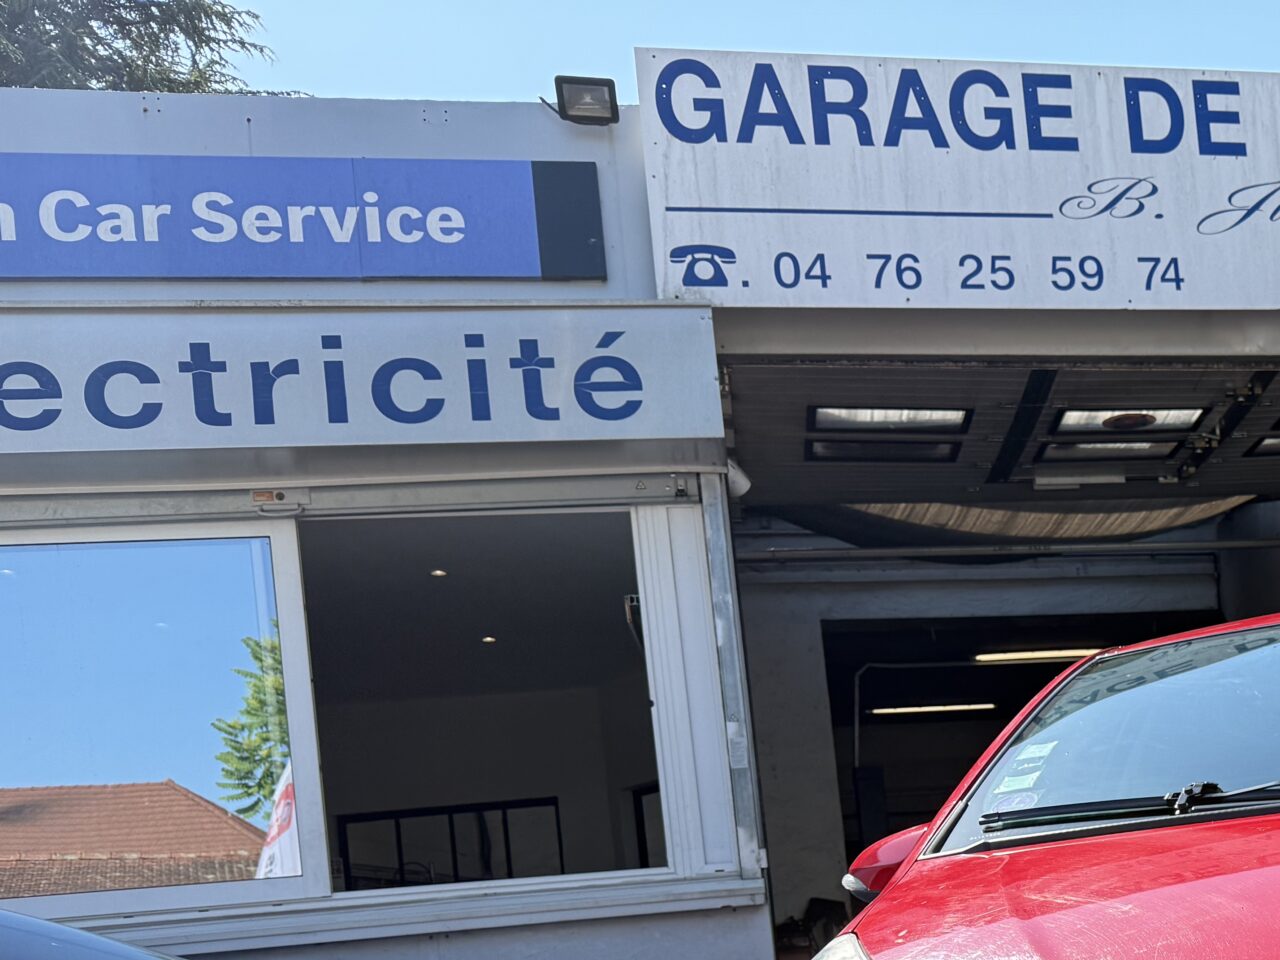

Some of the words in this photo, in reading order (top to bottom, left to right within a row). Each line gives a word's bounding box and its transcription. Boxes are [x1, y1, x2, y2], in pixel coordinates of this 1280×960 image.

[654, 58, 1080, 152] GARAGE
[1123, 76, 1247, 157] DE
[39, 190, 171, 243] Car
[191, 191, 466, 244] Service
[1058, 176, 1164, 220] B.
[773, 252, 832, 289] 04
[866, 253, 922, 290] 76
[958, 254, 1016, 291] 25
[1050, 255, 1104, 291] 59
[1137, 256, 1185, 291] 74
[0, 331, 644, 431] ectricité
